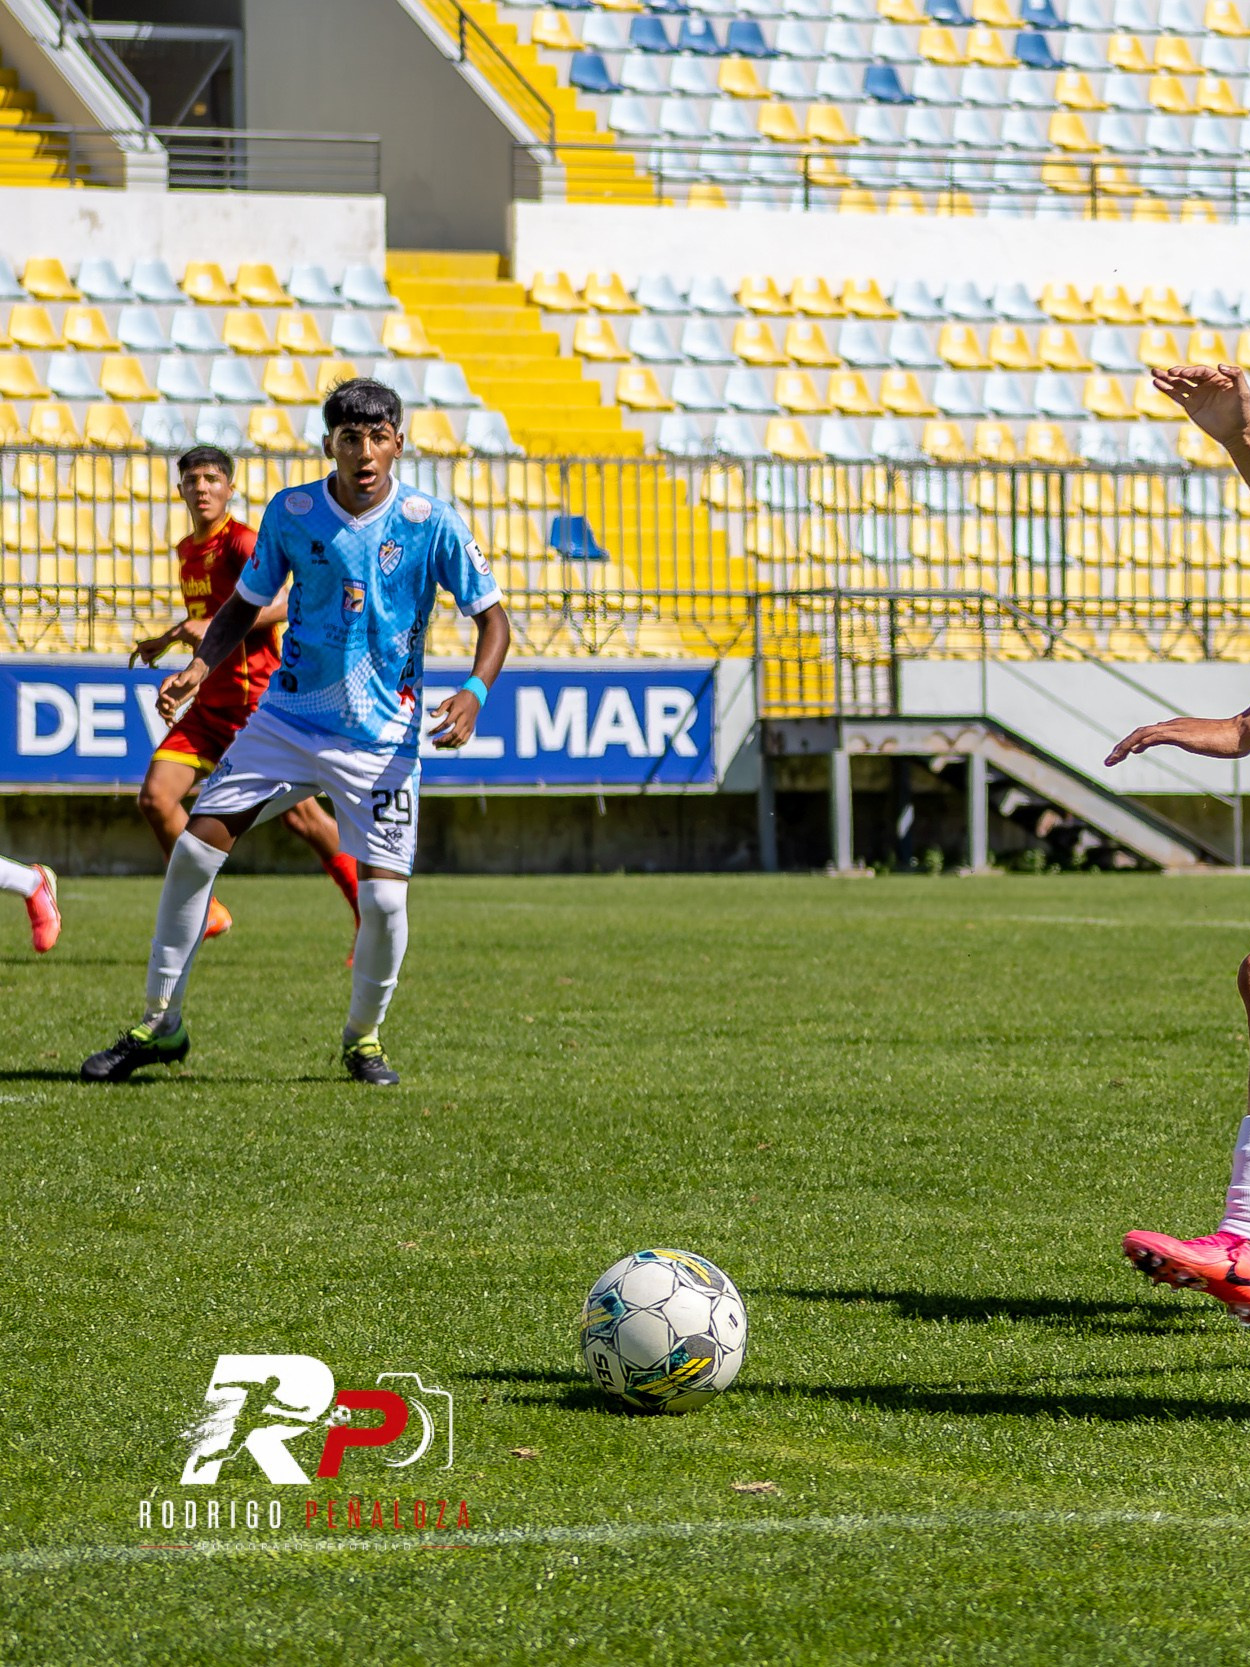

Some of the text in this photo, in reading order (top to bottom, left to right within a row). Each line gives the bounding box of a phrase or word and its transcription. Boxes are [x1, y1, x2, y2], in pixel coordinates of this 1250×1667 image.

[17, 682, 127, 757] DE
[515, 686, 699, 758] MAR
[371, 789, 412, 826] 29
